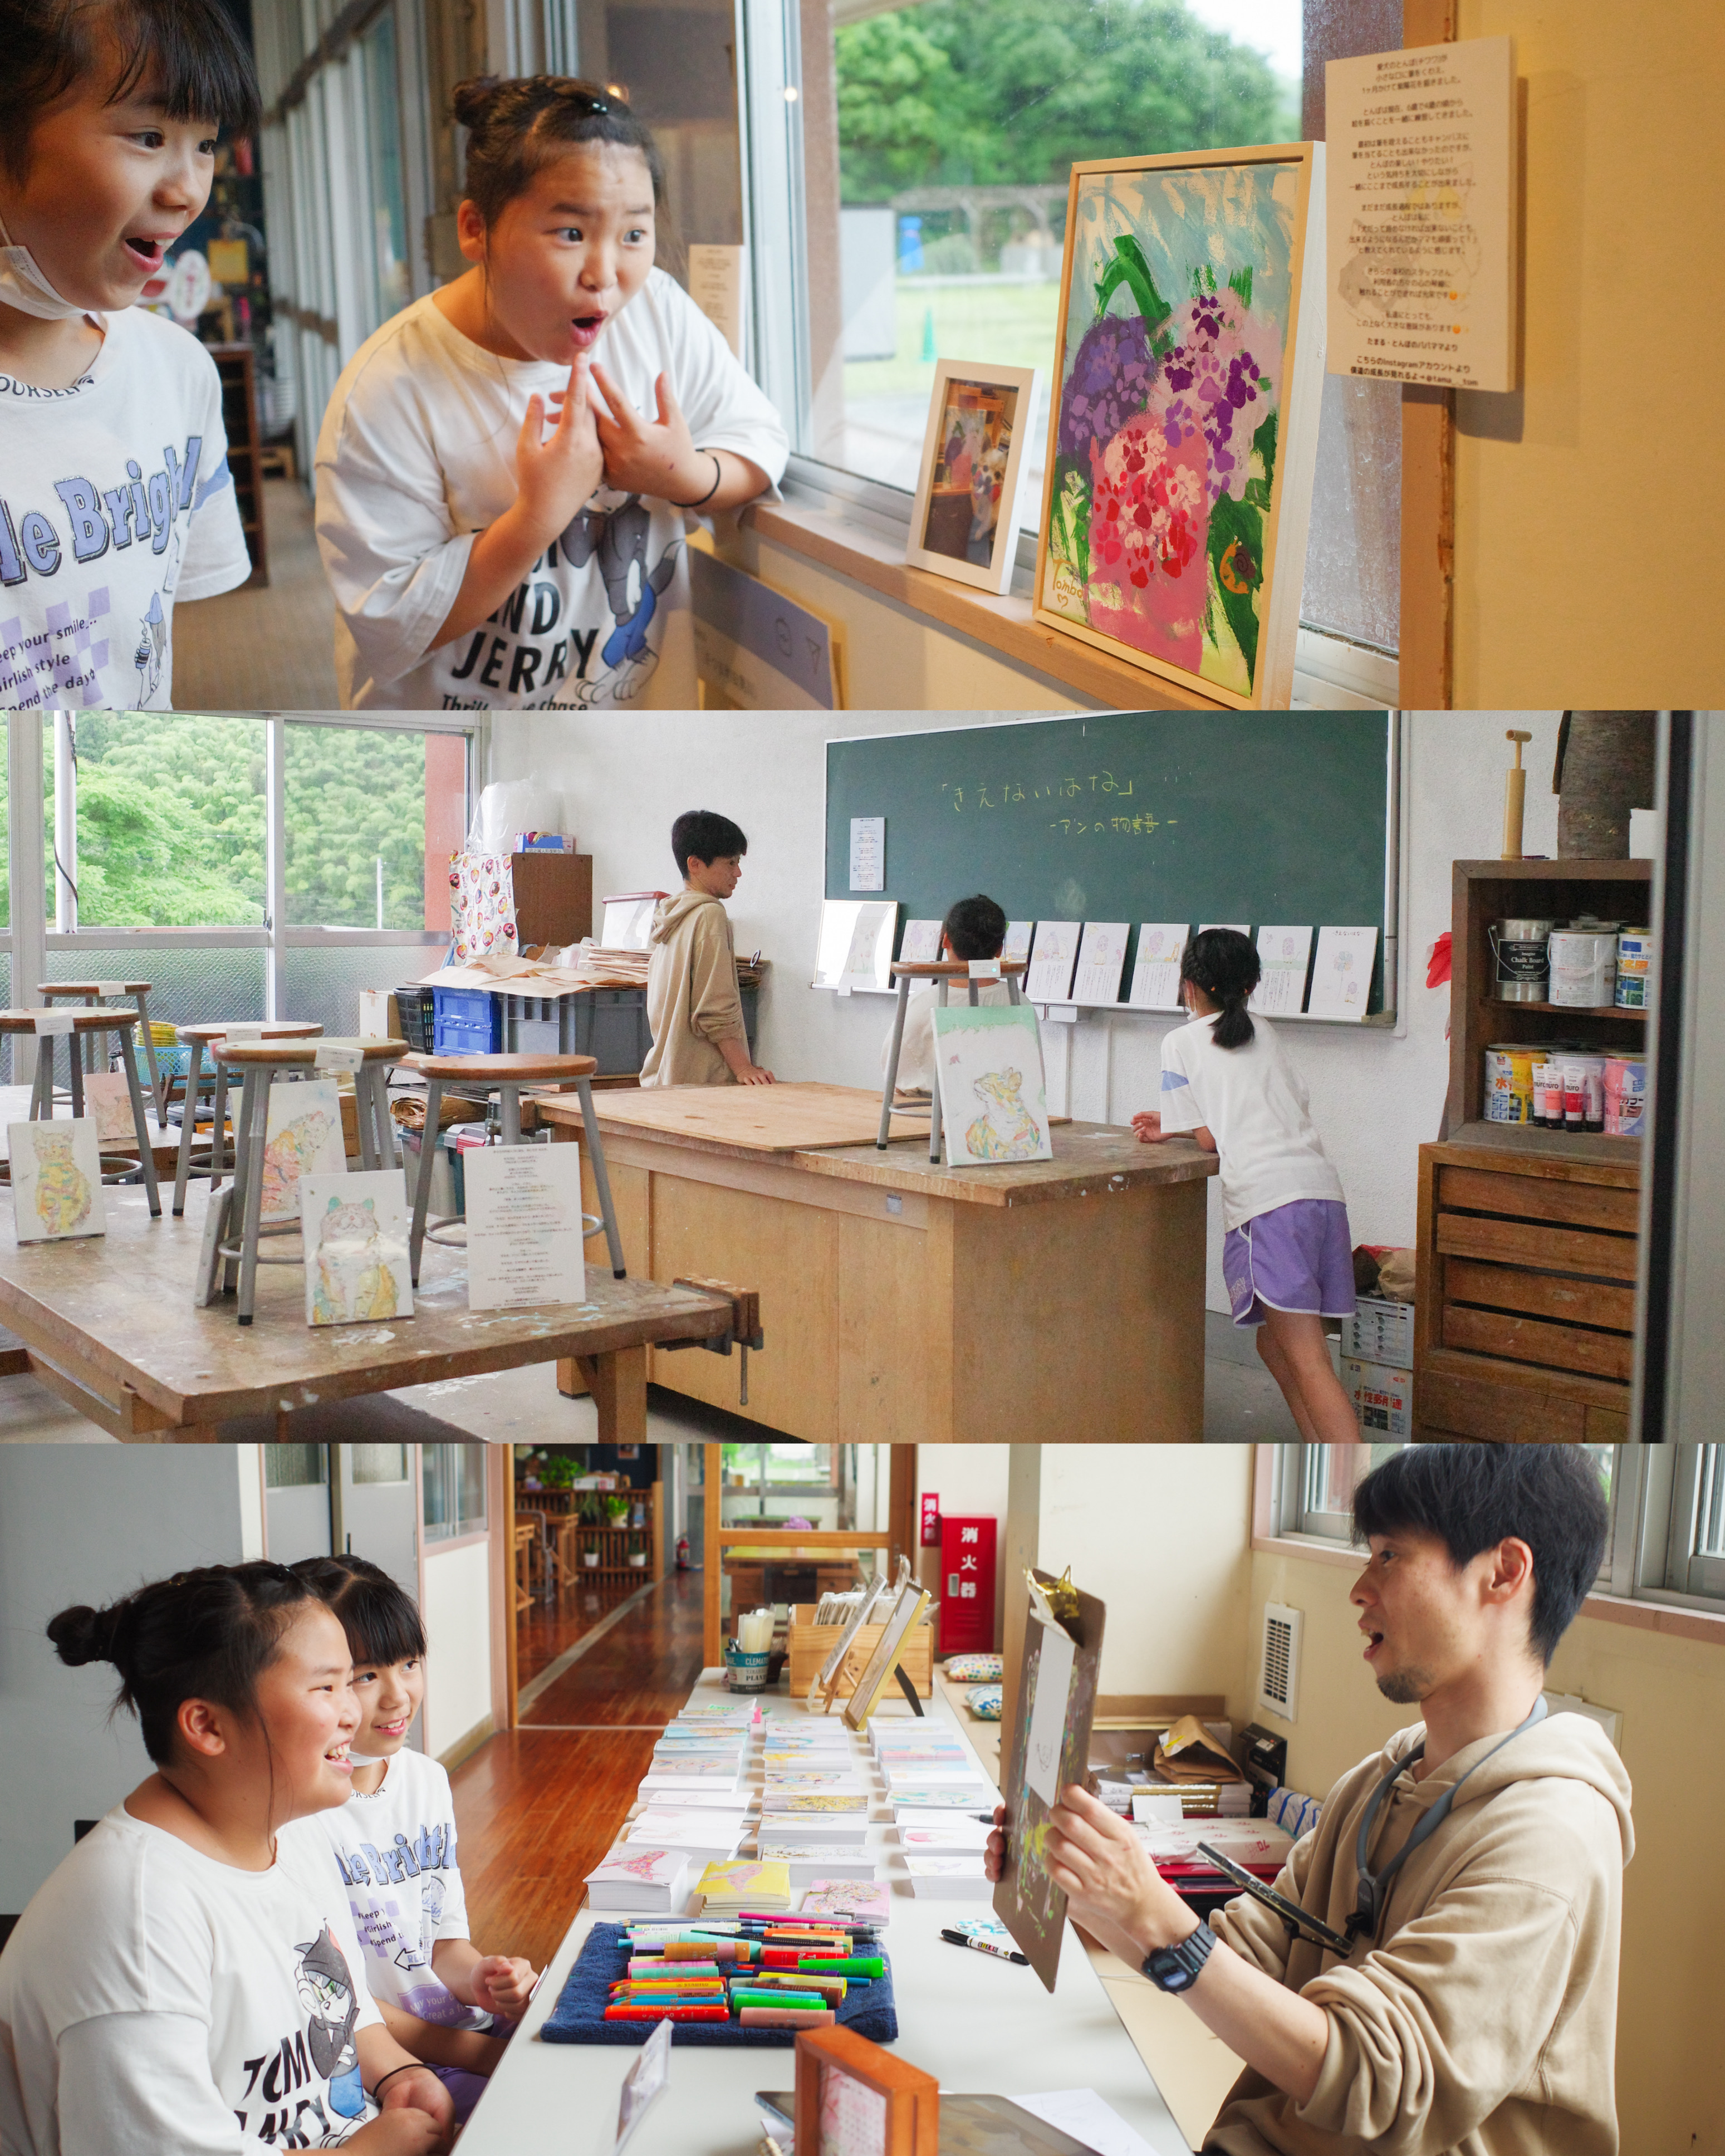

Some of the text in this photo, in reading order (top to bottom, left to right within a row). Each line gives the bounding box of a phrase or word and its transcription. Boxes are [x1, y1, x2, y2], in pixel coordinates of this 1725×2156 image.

[1052, 558, 1083, 599] Tombo
[18, 633, 49, 654] your
[450, 629, 599, 694] JERRY
[0, 654, 70, 693] irlish style
[42, 683, 58, 699] the
[960, 1527, 978, 1598] 消火器
